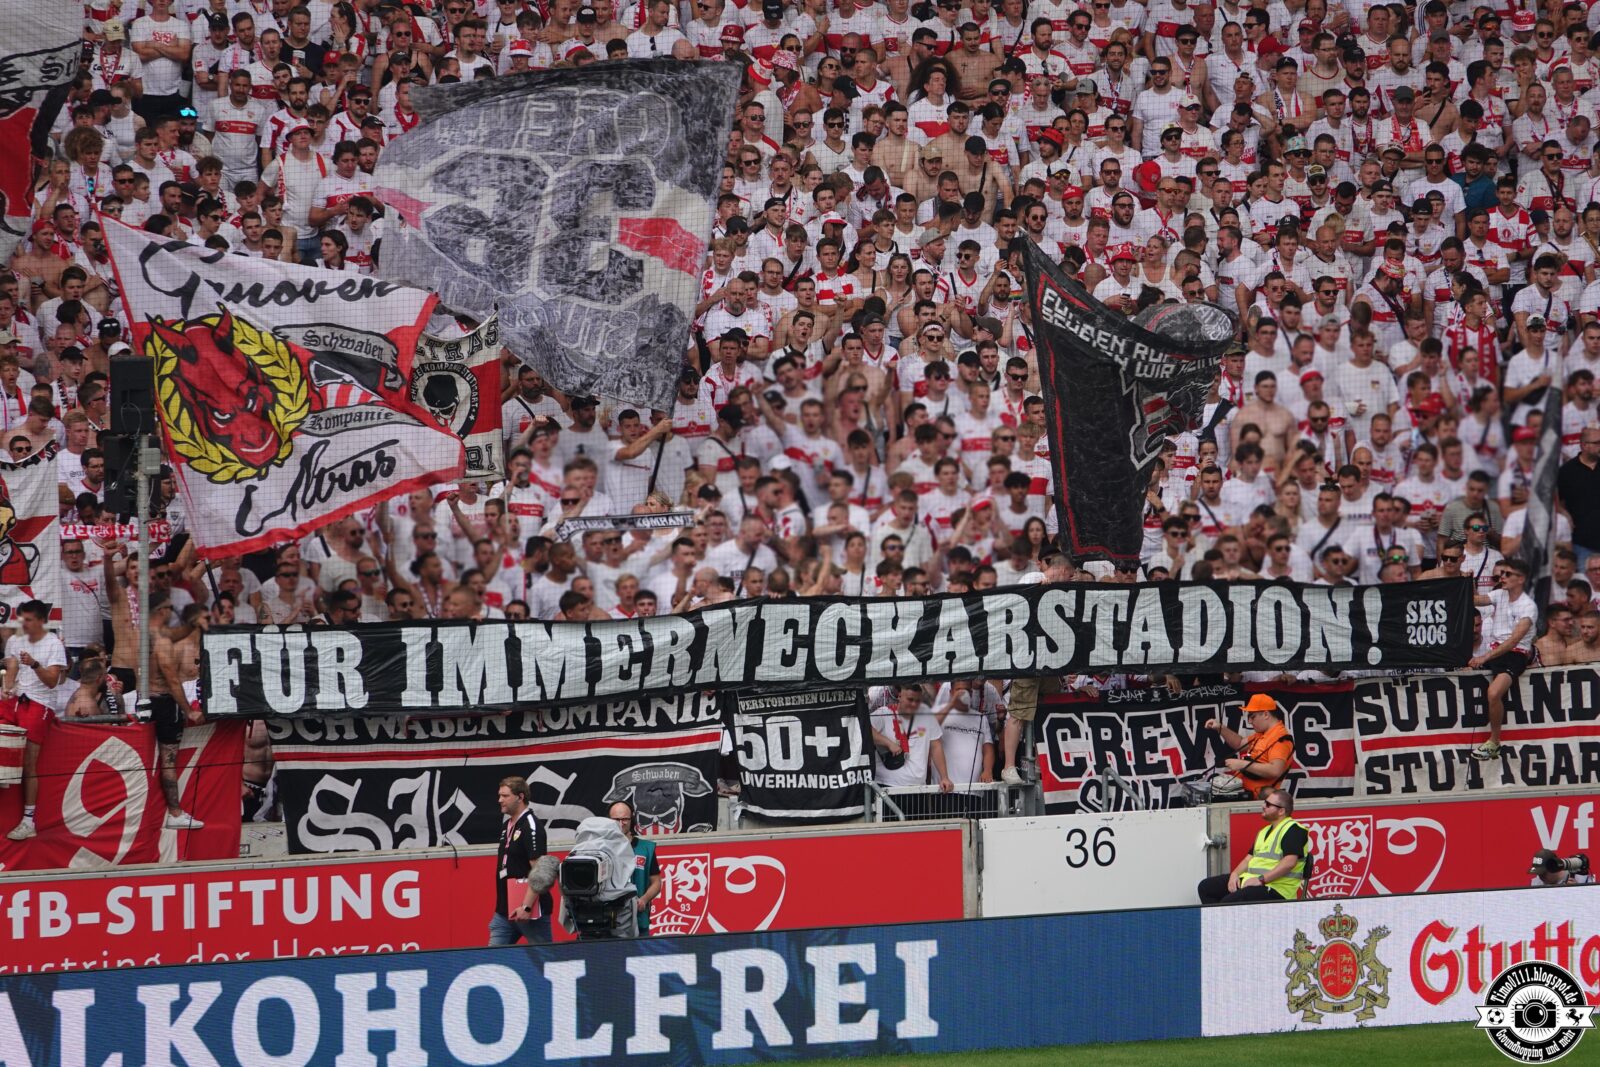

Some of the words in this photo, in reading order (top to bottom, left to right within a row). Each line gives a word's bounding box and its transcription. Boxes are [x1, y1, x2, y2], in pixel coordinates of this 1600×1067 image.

[302, 329, 384, 361] Schwaben
[305, 408, 395, 431] Kompanie
[1405, 599, 1447, 624] SKS
[1406, 624, 1447, 646] 2006
[203, 622, 369, 715] FÜR
[739, 694, 818, 711] VERSTORBENEN
[819, 690, 857, 703] ULTRAS
[733, 713, 871, 771] 50+1
[1042, 701, 1245, 781] CREW
[631, 768, 680, 782] Schwaben
[740, 768, 873, 789] UNVERHANDELBAR
[1065, 827, 1116, 868] 36
[1342, 864, 1353, 873] 93
[0, 870, 421, 940] fB-STIFTUNG
[680, 903, 691, 912] 93
